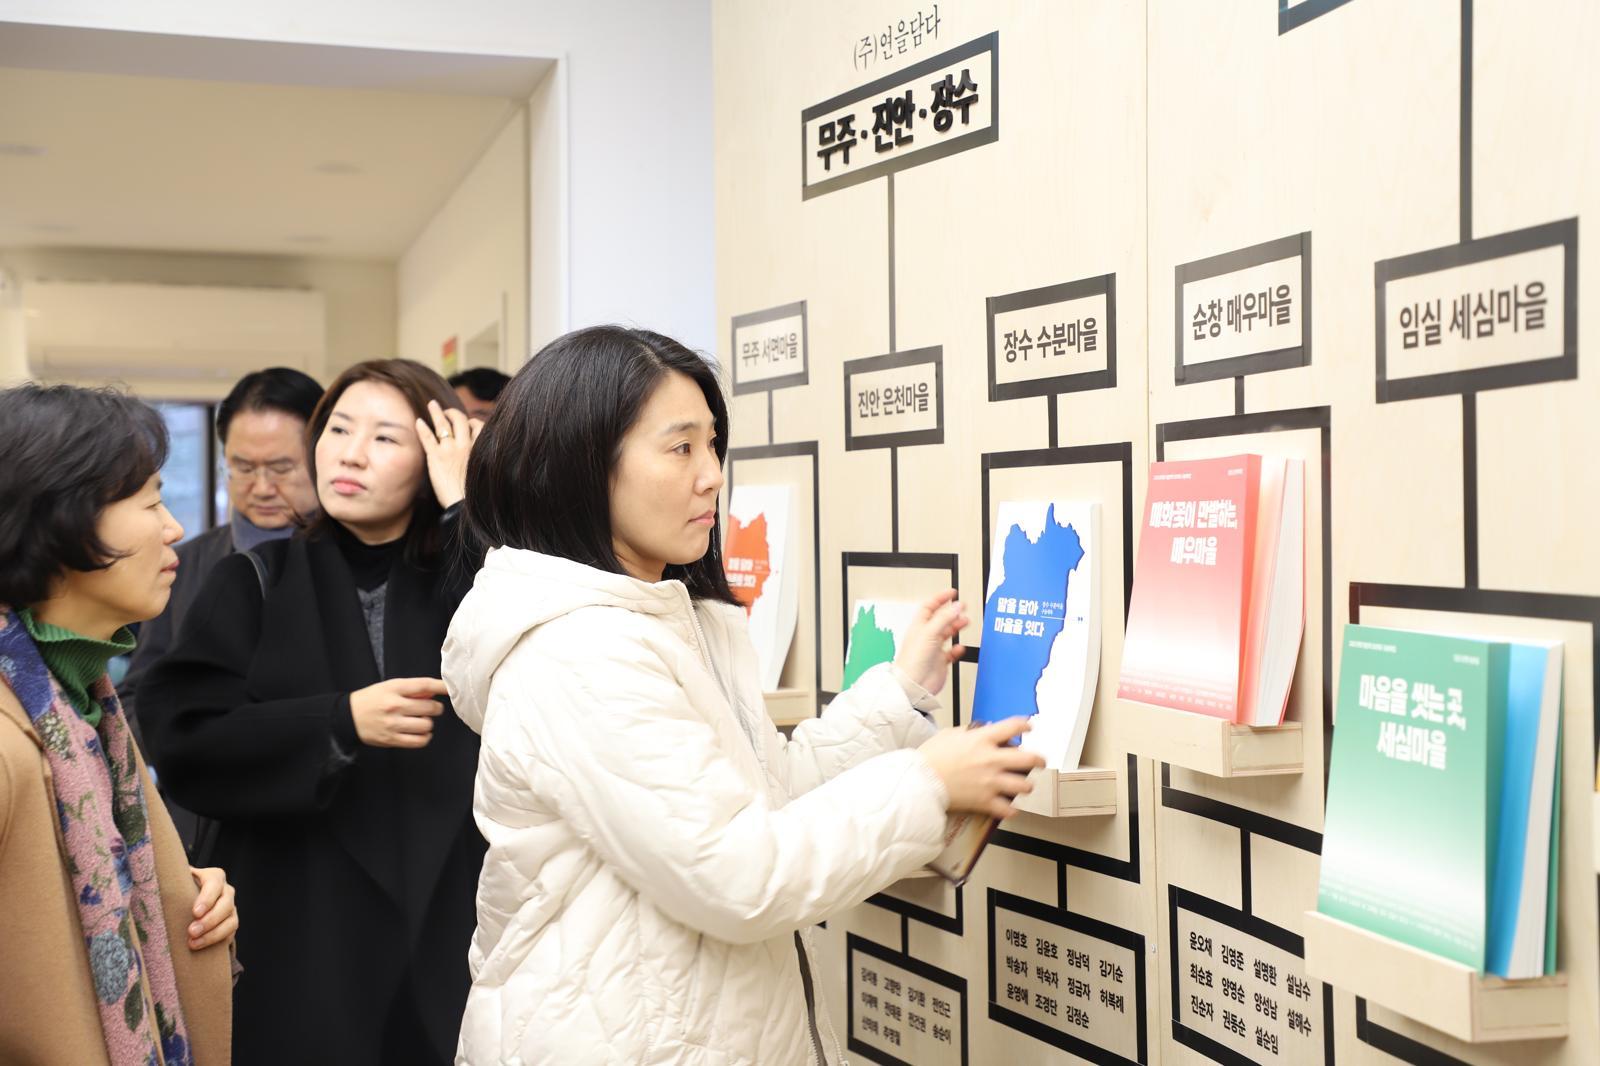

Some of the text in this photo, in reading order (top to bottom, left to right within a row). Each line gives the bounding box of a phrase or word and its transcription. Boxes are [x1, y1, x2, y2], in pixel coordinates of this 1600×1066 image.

[853, 4, 941, 71] (주)연을담다
[1192, 283, 1292, 341] 순창 매우마을
[1400, 281, 1548, 350] 임실 세심마을
[742, 340, 760, 368] 무주
[1003, 316, 1098, 363] 장수 수분마을
[858, 382, 930, 418] 진안 은천마을
[1170, 536, 1218, 566] 매우마을
[1018, 600, 1039, 617] 담아
[1359, 674, 1467, 731] 마음을 씻는 곳
[1376, 721, 1447, 770] 세심마을
[1036, 938, 1059, 959] 김윤호
[1067, 949, 1091, 972] 정남덕
[1099, 960, 1124, 984] 김기순
[1221, 945, 1245, 971] 김영준
[1286, 974, 1311, 1001] 설남수
[1036, 966, 1059, 989] 박숙자
[1067, 977, 1091, 1001] 정금자
[1100, 989, 1125, 1014] 허복례
[1190, 963, 1214, 988] 최순효
[1221, 977, 1245, 1004] 양영순
[1254, 992, 1278, 1021] 양성남
[1066, 1006, 1090, 1029] 김정순
[1190, 995, 1279, 1055] 진순자 권동순 설순임
